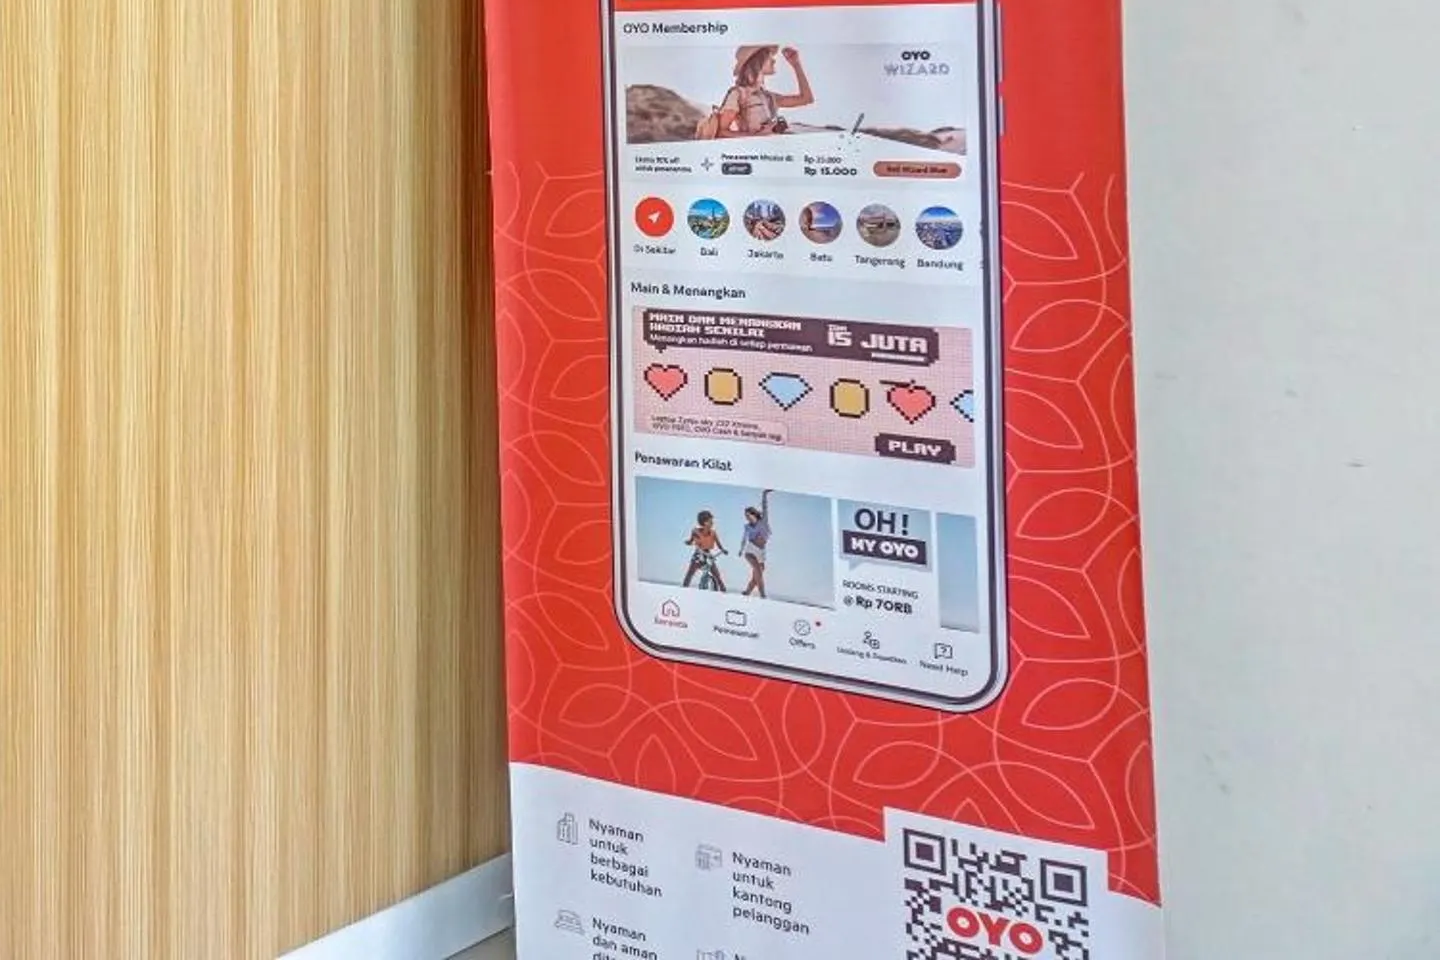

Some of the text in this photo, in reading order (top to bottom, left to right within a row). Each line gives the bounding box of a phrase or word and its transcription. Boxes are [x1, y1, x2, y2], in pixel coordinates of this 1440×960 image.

[623, 22, 728, 35] OYO Membership
[901, 50, 931, 60] OYO
[804, 166, 857, 176] Rp 15.000
[855, 255, 906, 269] Tangerang
[917, 258, 964, 271] Bandung
[630, 281, 746, 300] Main & Menangkan
[860, 333, 928, 354] JUTA
[888, 440, 941, 456] PLAY
[634, 451, 733, 471] Penawaran Kilat
[879, 540, 919, 558] OYO
[856, 595, 872, 609] Rp
[588, 818, 644, 842] Nyaman
[589, 837, 628, 856] untuk
[590, 853, 649, 878] berbagai
[732, 851, 792, 877] Nyaman
[590, 868, 663, 898] kebutuhan
[732, 871, 775, 891] untuk
[732, 886, 793, 914] kantong
[592, 917, 646, 941] Nyaman
[732, 906, 810, 935] pelanggan
[947, 906, 1044, 954] OYO
[592, 935, 617, 951] dan
[621, 944, 658, 960] aman
